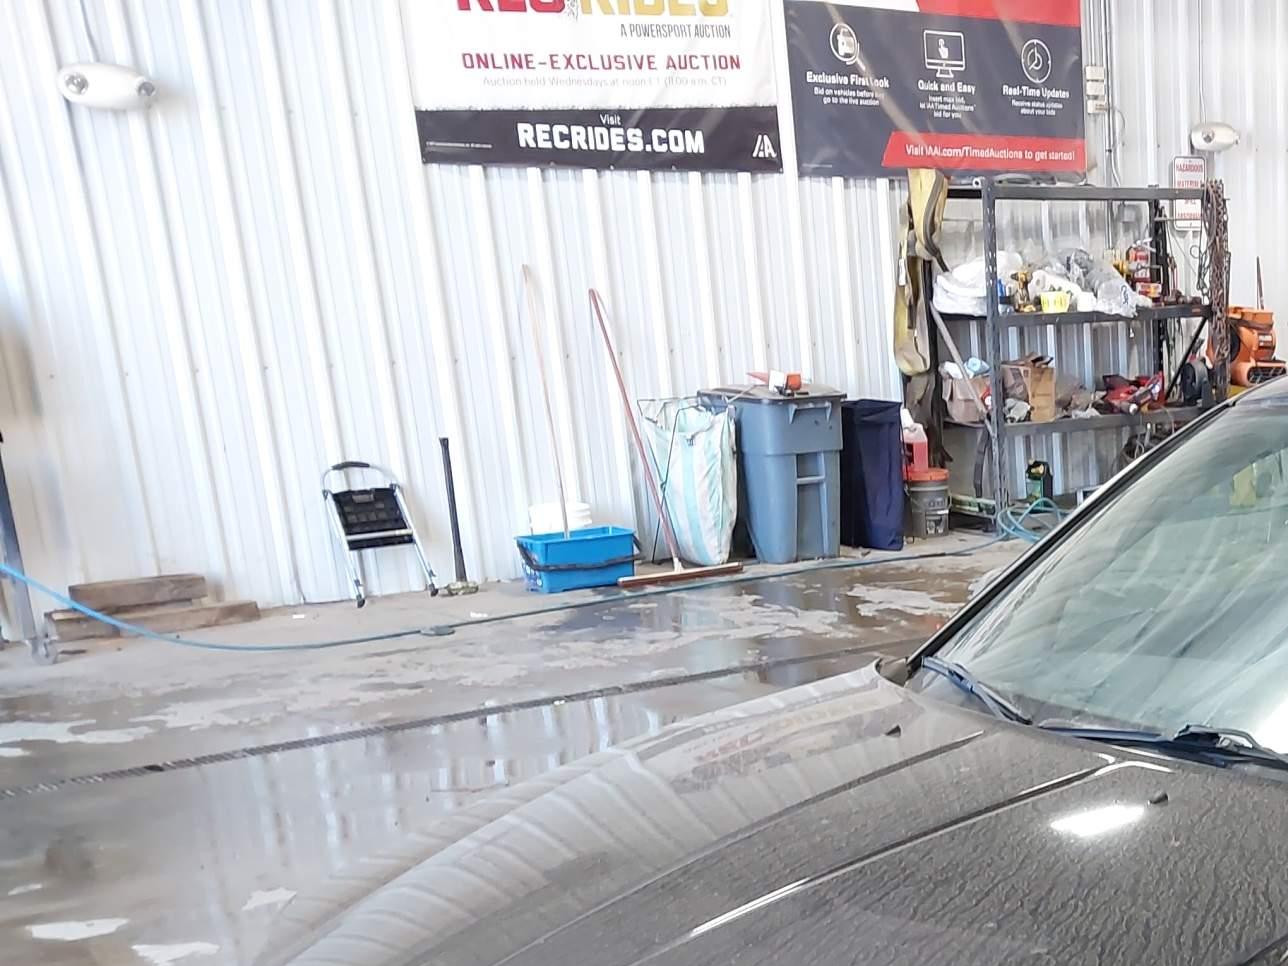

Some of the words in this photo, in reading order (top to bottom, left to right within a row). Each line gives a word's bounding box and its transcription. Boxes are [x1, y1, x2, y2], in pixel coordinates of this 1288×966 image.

[629, 23, 692, 39] POWERSPORT
[694, 23, 732, 39] AUCTION
[461, 52, 658, 71] ONLINE-EXCLUSIVE
[665, 54, 742, 71] AUCTION
[806, 70, 848, 85] Exclusive
[850, 74, 870, 86] First
[918, 80, 938, 91] Quick
[940, 80, 956, 91] and
[956, 82, 976, 94] Easy
[1002, 84, 1040, 97] Real-Time
[1042, 88, 1070, 99] Updates
[599, 113, 622, 126] Visit
[516, 122, 706, 154] RECRIDES.COM
[906, 144, 924, 155] Visit
[1024, 150, 1034, 158] to
[1034, 150, 1048, 161] get
